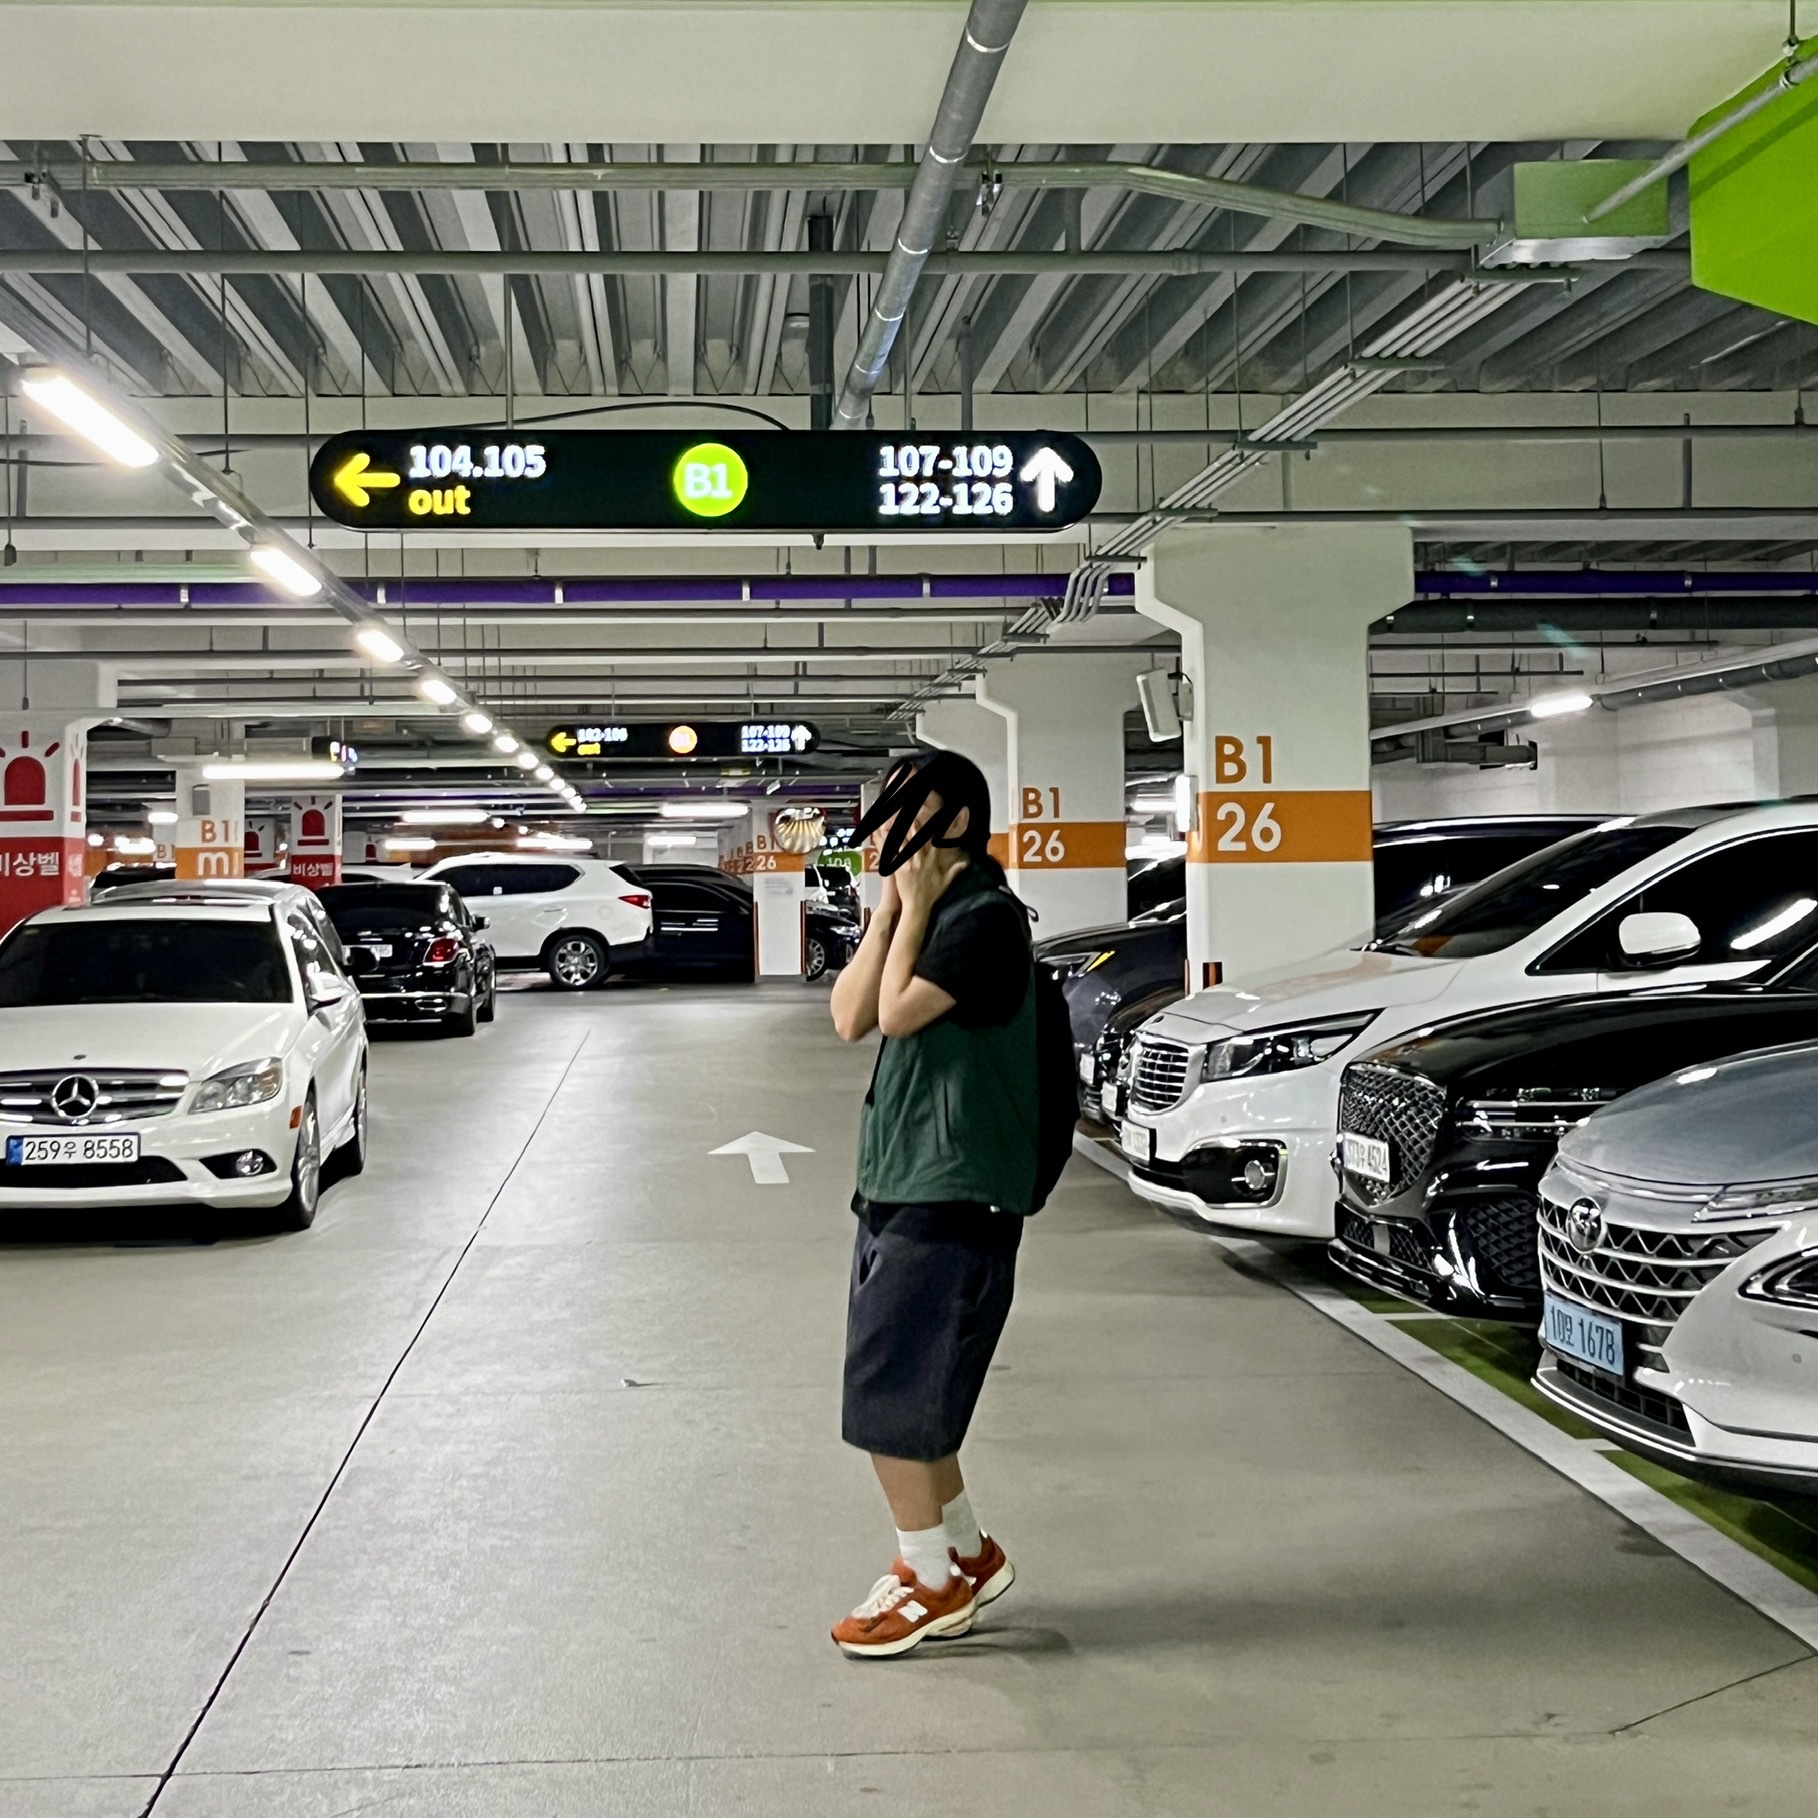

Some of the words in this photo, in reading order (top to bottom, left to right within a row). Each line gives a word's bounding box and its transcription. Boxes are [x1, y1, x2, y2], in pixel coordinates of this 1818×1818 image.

[879, 445, 1014, 477] 107-109
[683, 462, 733, 499] B1
[408, 485, 471, 515] out
[879, 482, 1014, 515] 122-126
[1215, 735, 1272, 784] B1
[1022, 787, 1060, 819] B1
[201, 820, 229, 843] B1
[1216, 801, 1282, 852] 26
[1022, 829, 1066, 863] 26
[756, 855, 777, 870] 26
[24, 1140, 76, 1161] 259우
[83, 1138, 134, 1160] 8558
[1578, 1318, 1616, 1366] 1678
